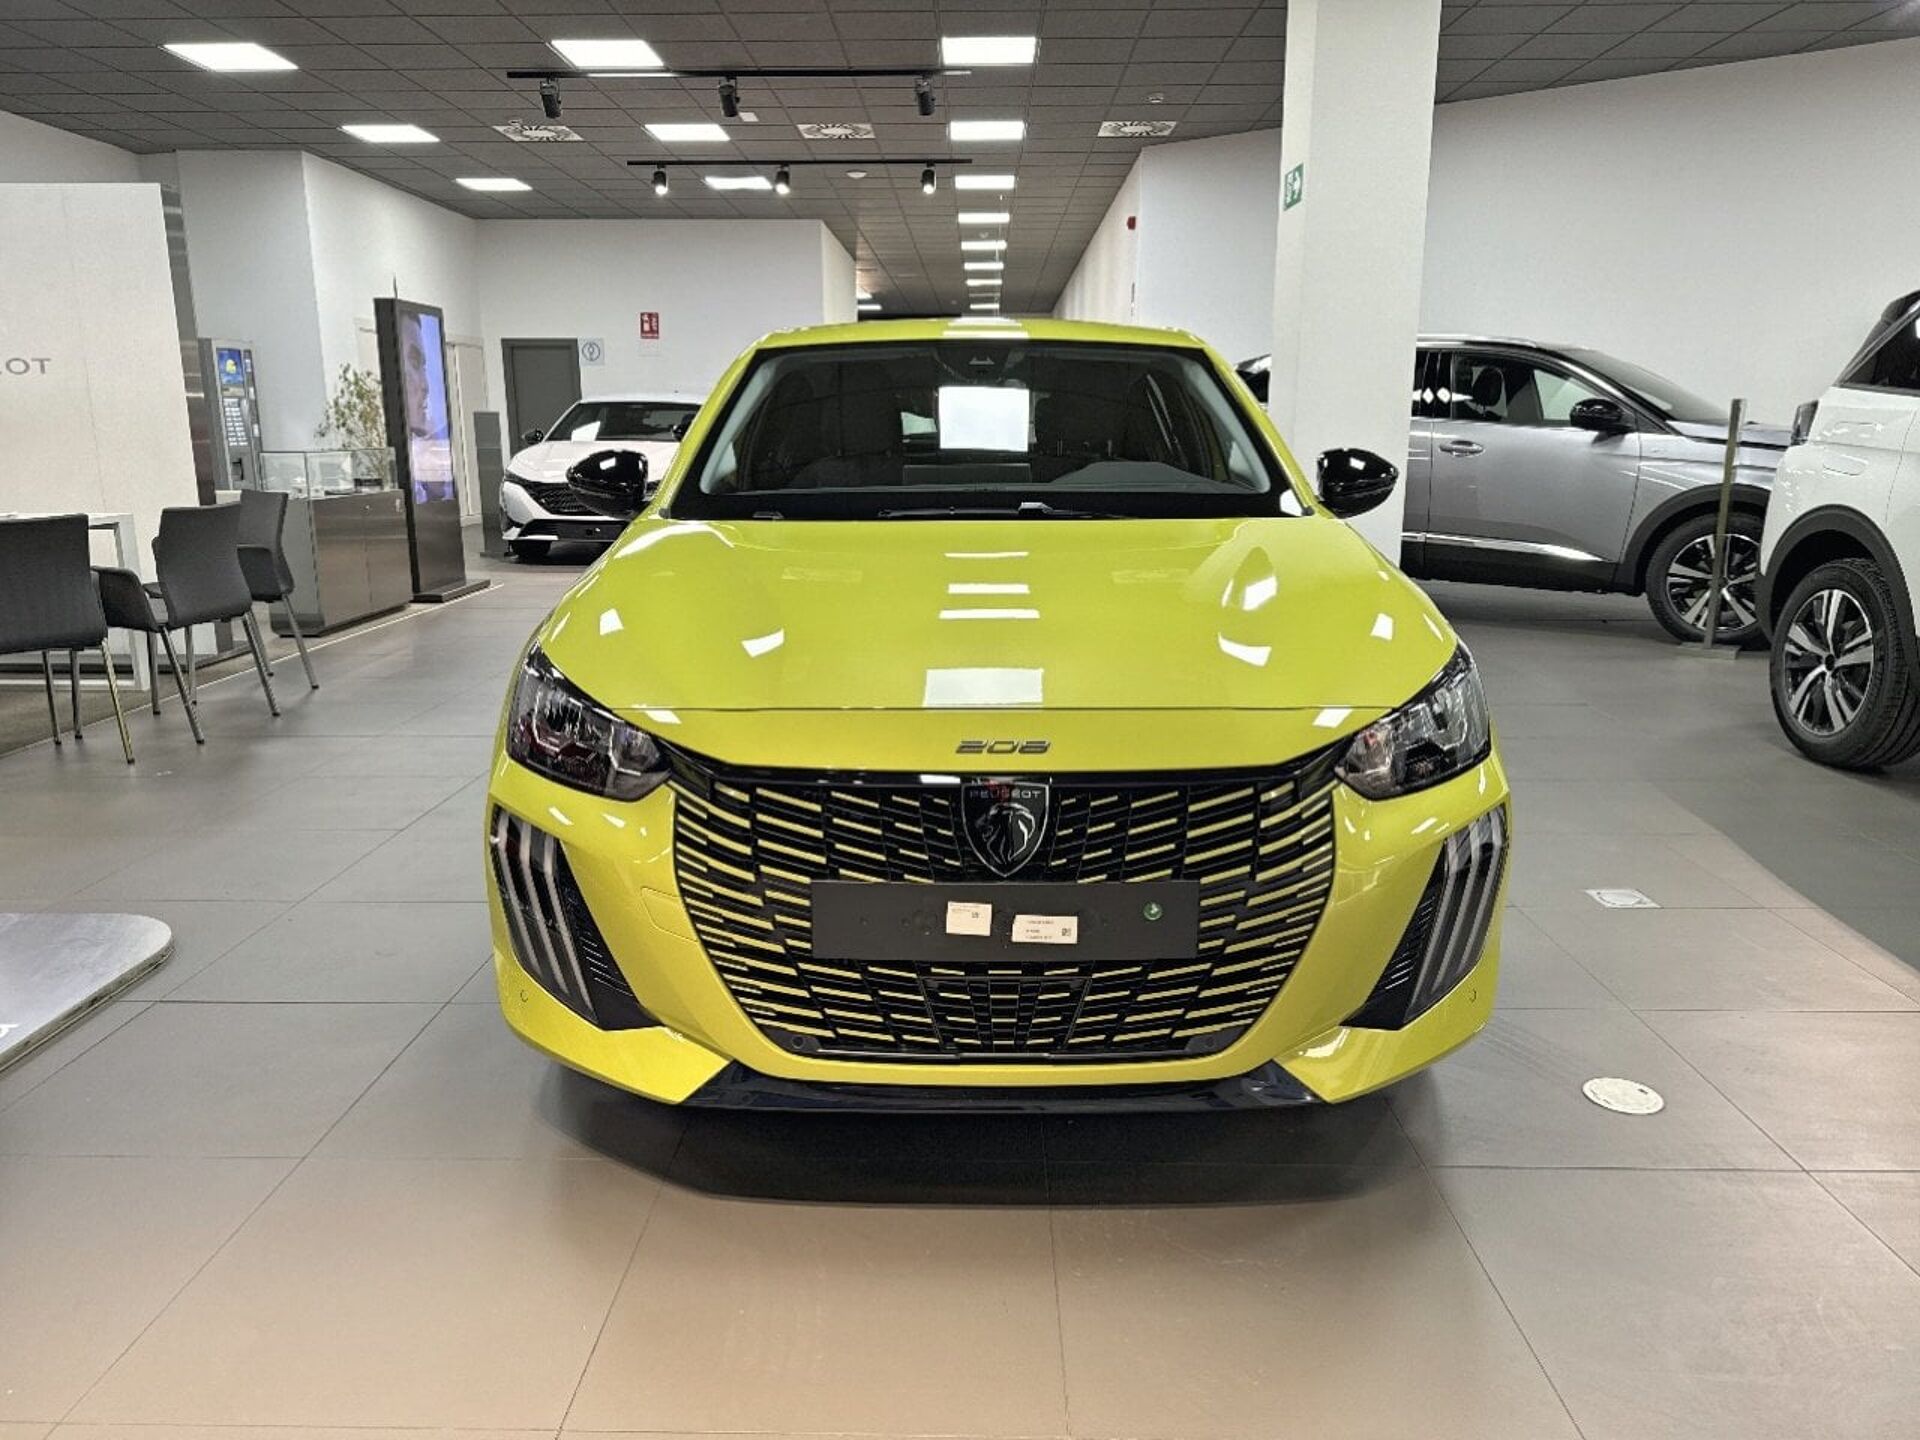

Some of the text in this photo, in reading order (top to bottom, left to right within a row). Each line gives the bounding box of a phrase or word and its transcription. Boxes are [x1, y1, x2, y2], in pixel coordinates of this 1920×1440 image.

[0, 358, 51, 375] OT
[956, 740, 1051, 754] 208
[969, 788, 1041, 799] PEUGEOT
